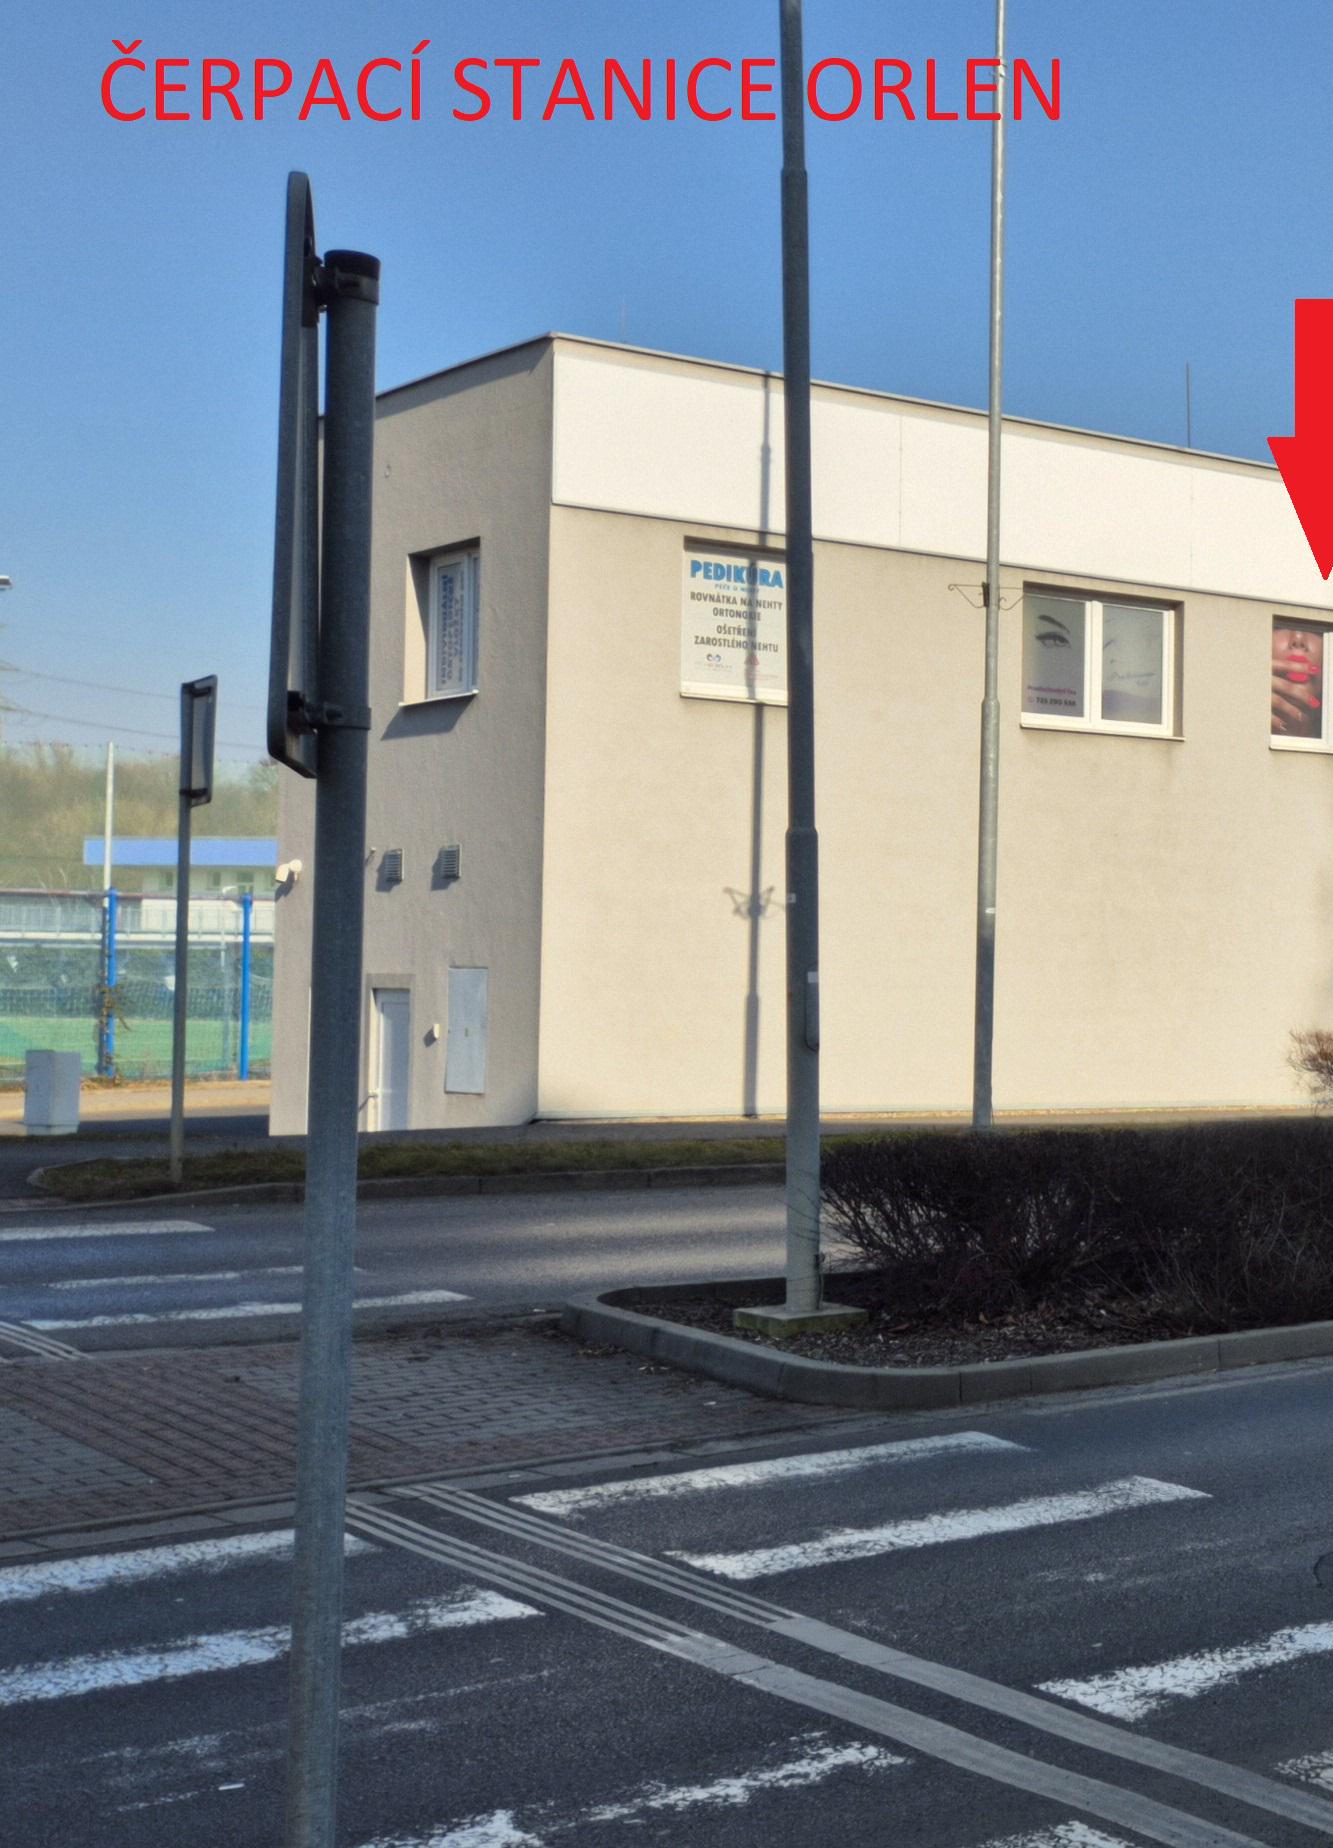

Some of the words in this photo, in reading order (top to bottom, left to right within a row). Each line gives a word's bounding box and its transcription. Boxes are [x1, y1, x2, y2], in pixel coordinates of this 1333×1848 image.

[690, 590, 737, 606] ROVNÁTKA
[740, 595, 753, 607] NA
[756, 597, 783, 611] NEHTY
[694, 634, 748, 651] ZAROSTLÉHO
[751, 640, 779, 653] NEHTU
